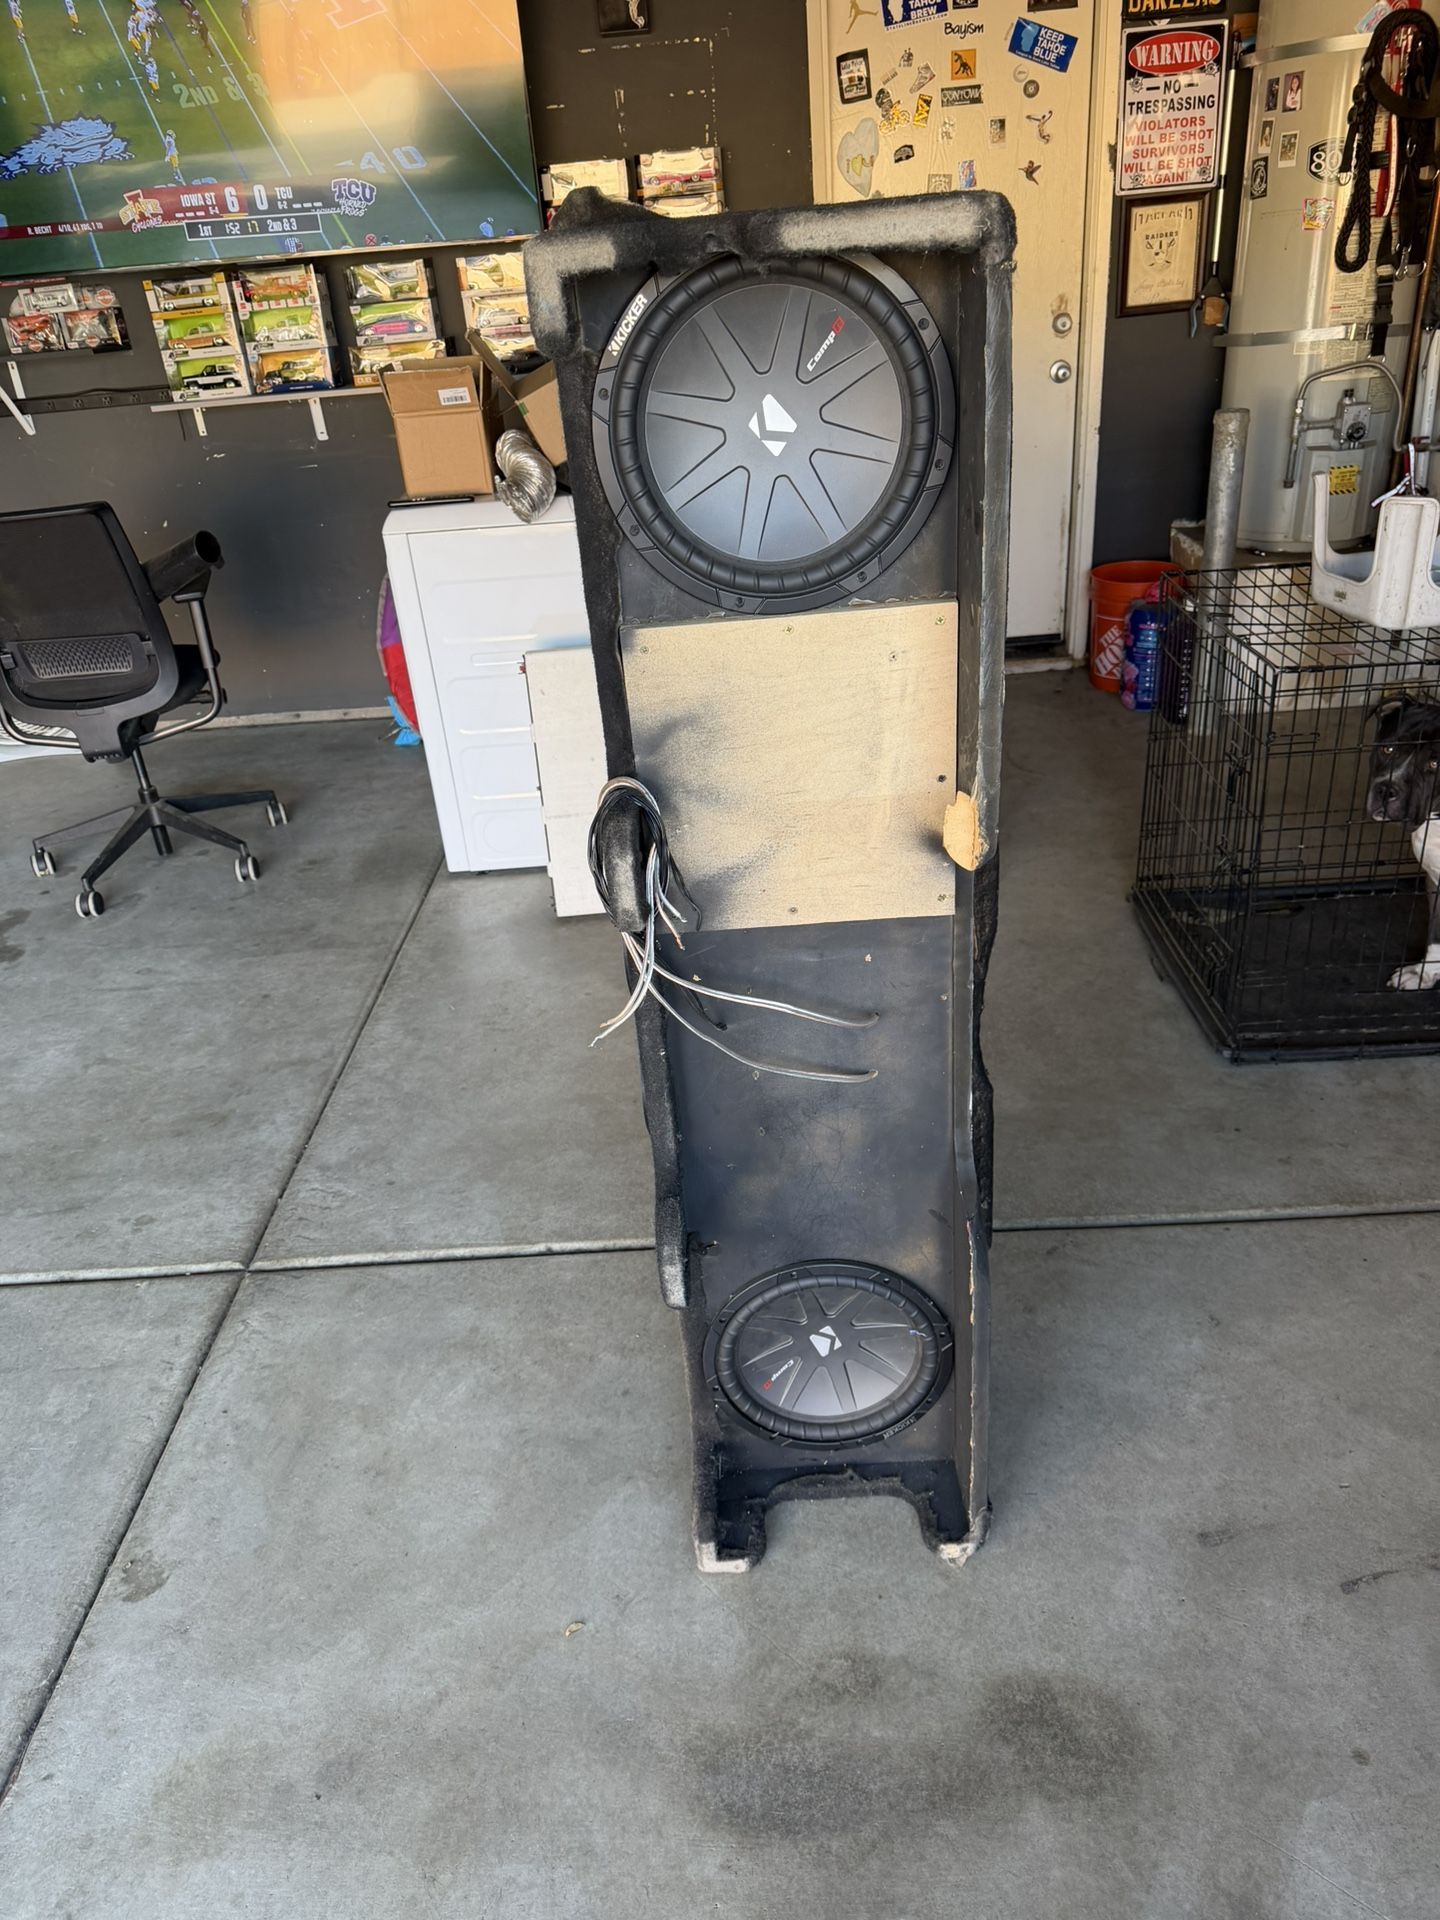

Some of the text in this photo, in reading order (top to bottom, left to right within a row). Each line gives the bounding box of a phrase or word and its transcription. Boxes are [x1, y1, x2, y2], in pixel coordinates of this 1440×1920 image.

[910, 6, 937, 20] BREW
[944, 21, 984, 39] Bayism
[1040, 27, 1065, 42] KEEP
[1033, 46, 1058, 63] BLUE
[1037, 37, 1067, 56] TAHOE
[1135, 39, 1214, 67] WARNING
[173, 83, 219, 109] 2ND
[1163, 79, 1181, 95] NO
[1127, 94, 1215, 116] TRESPASSING
[1135, 115, 1206, 132] VIOLATORS
[1125, 128, 1214, 146] WILL BE SHOT
[1132, 143, 1205, 159] SURVIVORS
[1124, 155, 1212, 173] WILL BE SHOT
[1144, 171, 1189, 185] AGAIN!
[180, 186, 240, 213] IOWA ST 6
[253, 184, 293, 211] 0 TCU
[332, 178, 376, 204] TCU
[198, 223, 213, 237] 1ST
[267, 219, 283, 232] 2ND
[284, 219, 291, 231] &
[290, 218, 298, 230] 3
[1145, 230, 1179, 240] RAIDERS
[613, 294, 648, 347] KICKER
[1099, 625, 1122, 648] THE
[1094, 638, 1124, 677] HO
